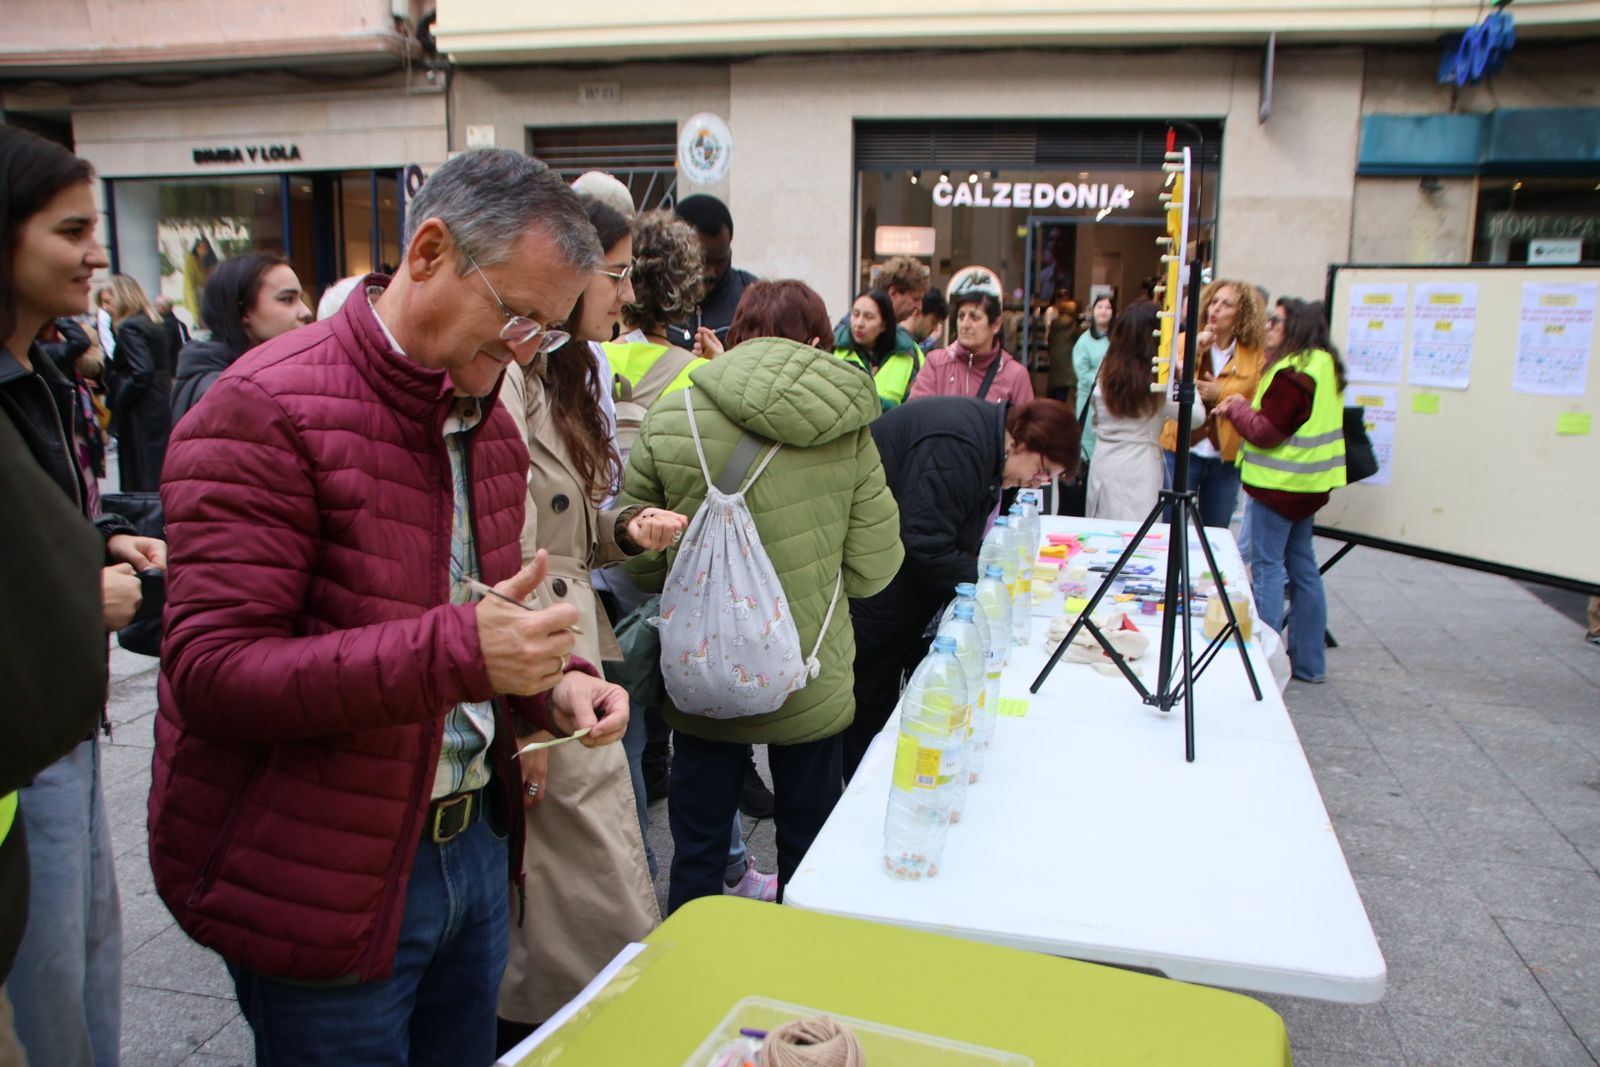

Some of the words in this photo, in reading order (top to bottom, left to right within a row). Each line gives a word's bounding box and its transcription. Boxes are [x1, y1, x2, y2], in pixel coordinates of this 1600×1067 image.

[193, 147, 243, 163] BIMBA
[246, 146, 257, 161] Y
[261, 144, 302, 161] LOLA
[932, 182, 1130, 208] CALZEDONIA
